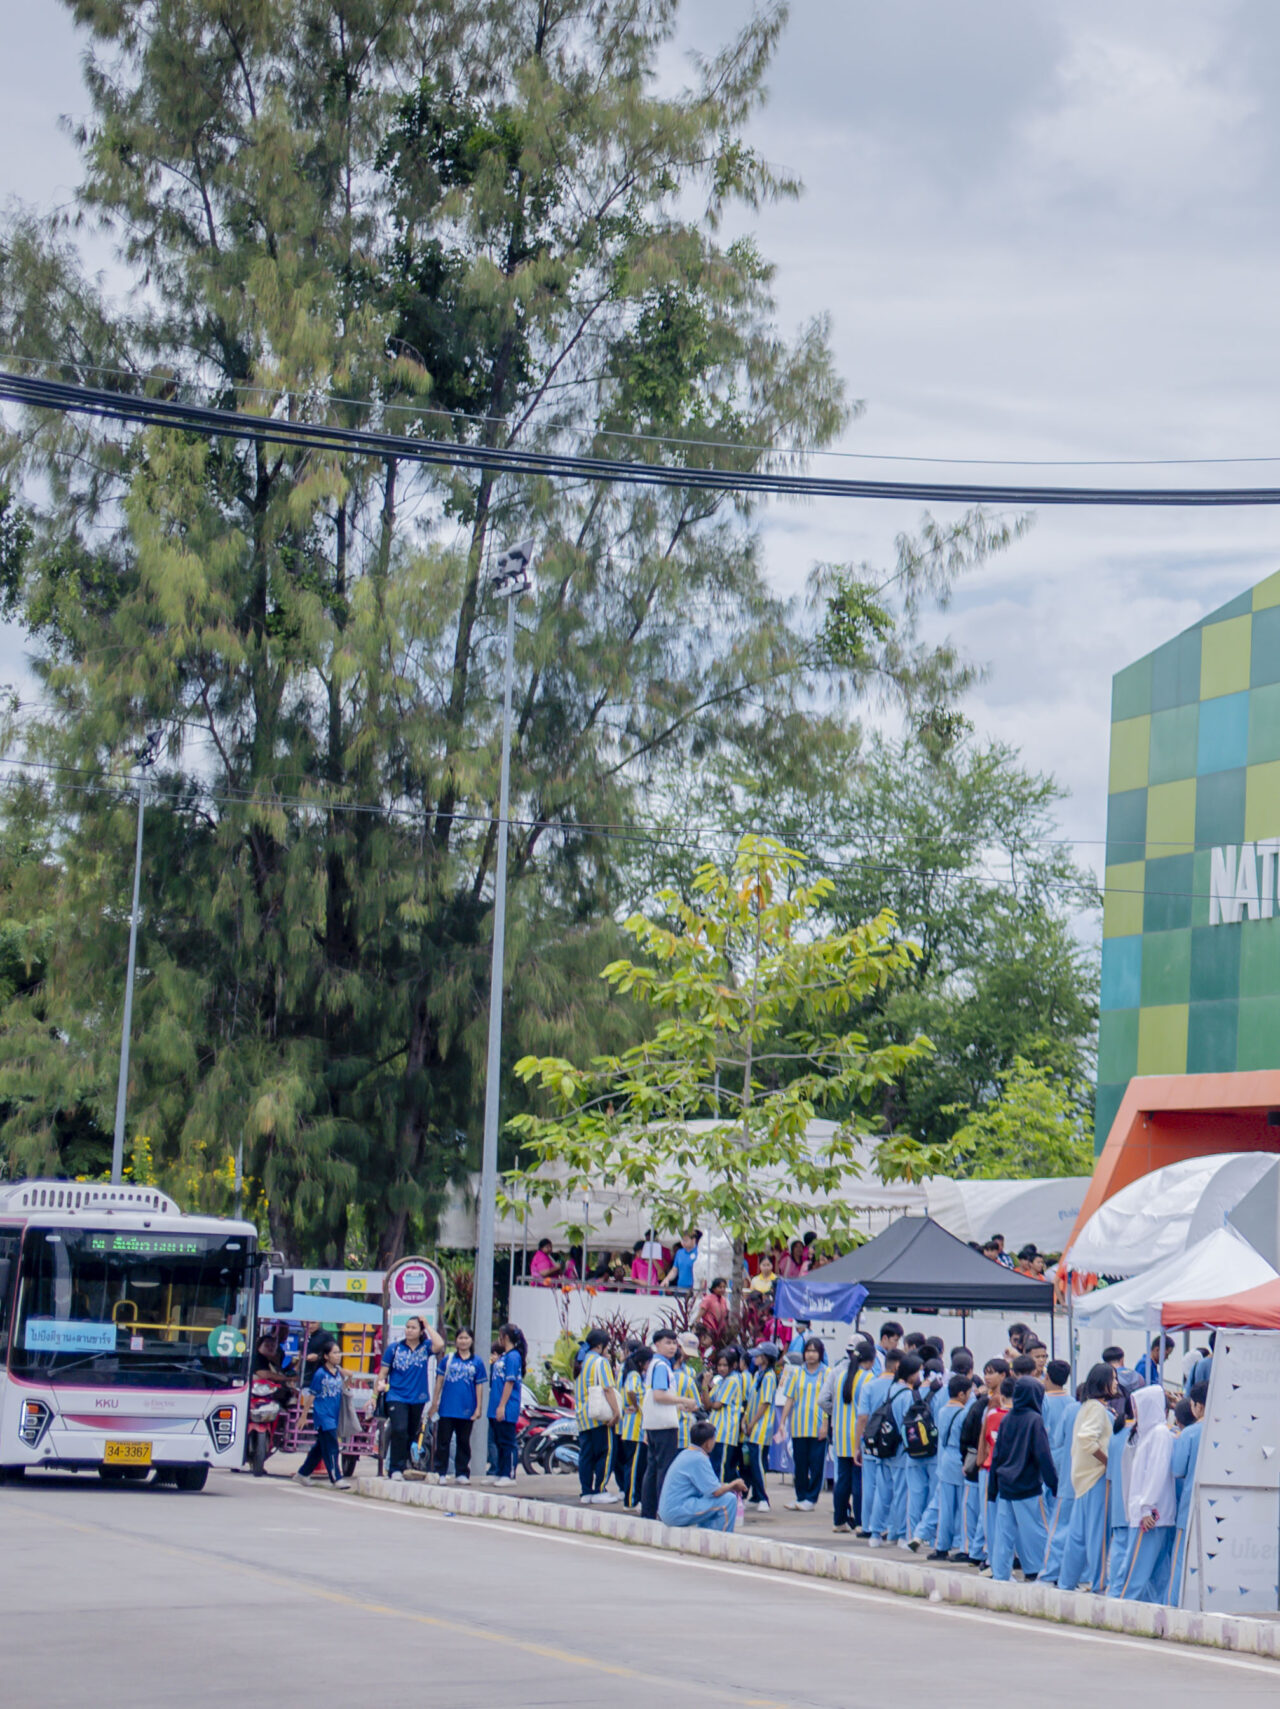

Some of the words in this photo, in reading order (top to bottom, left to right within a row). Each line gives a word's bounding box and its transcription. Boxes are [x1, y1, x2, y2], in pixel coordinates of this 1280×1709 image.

[216, 1331, 235, 1356] 5
[95, 1398, 119, 1409] KKU
[107, 1445, 149, 1458] 34-3367
